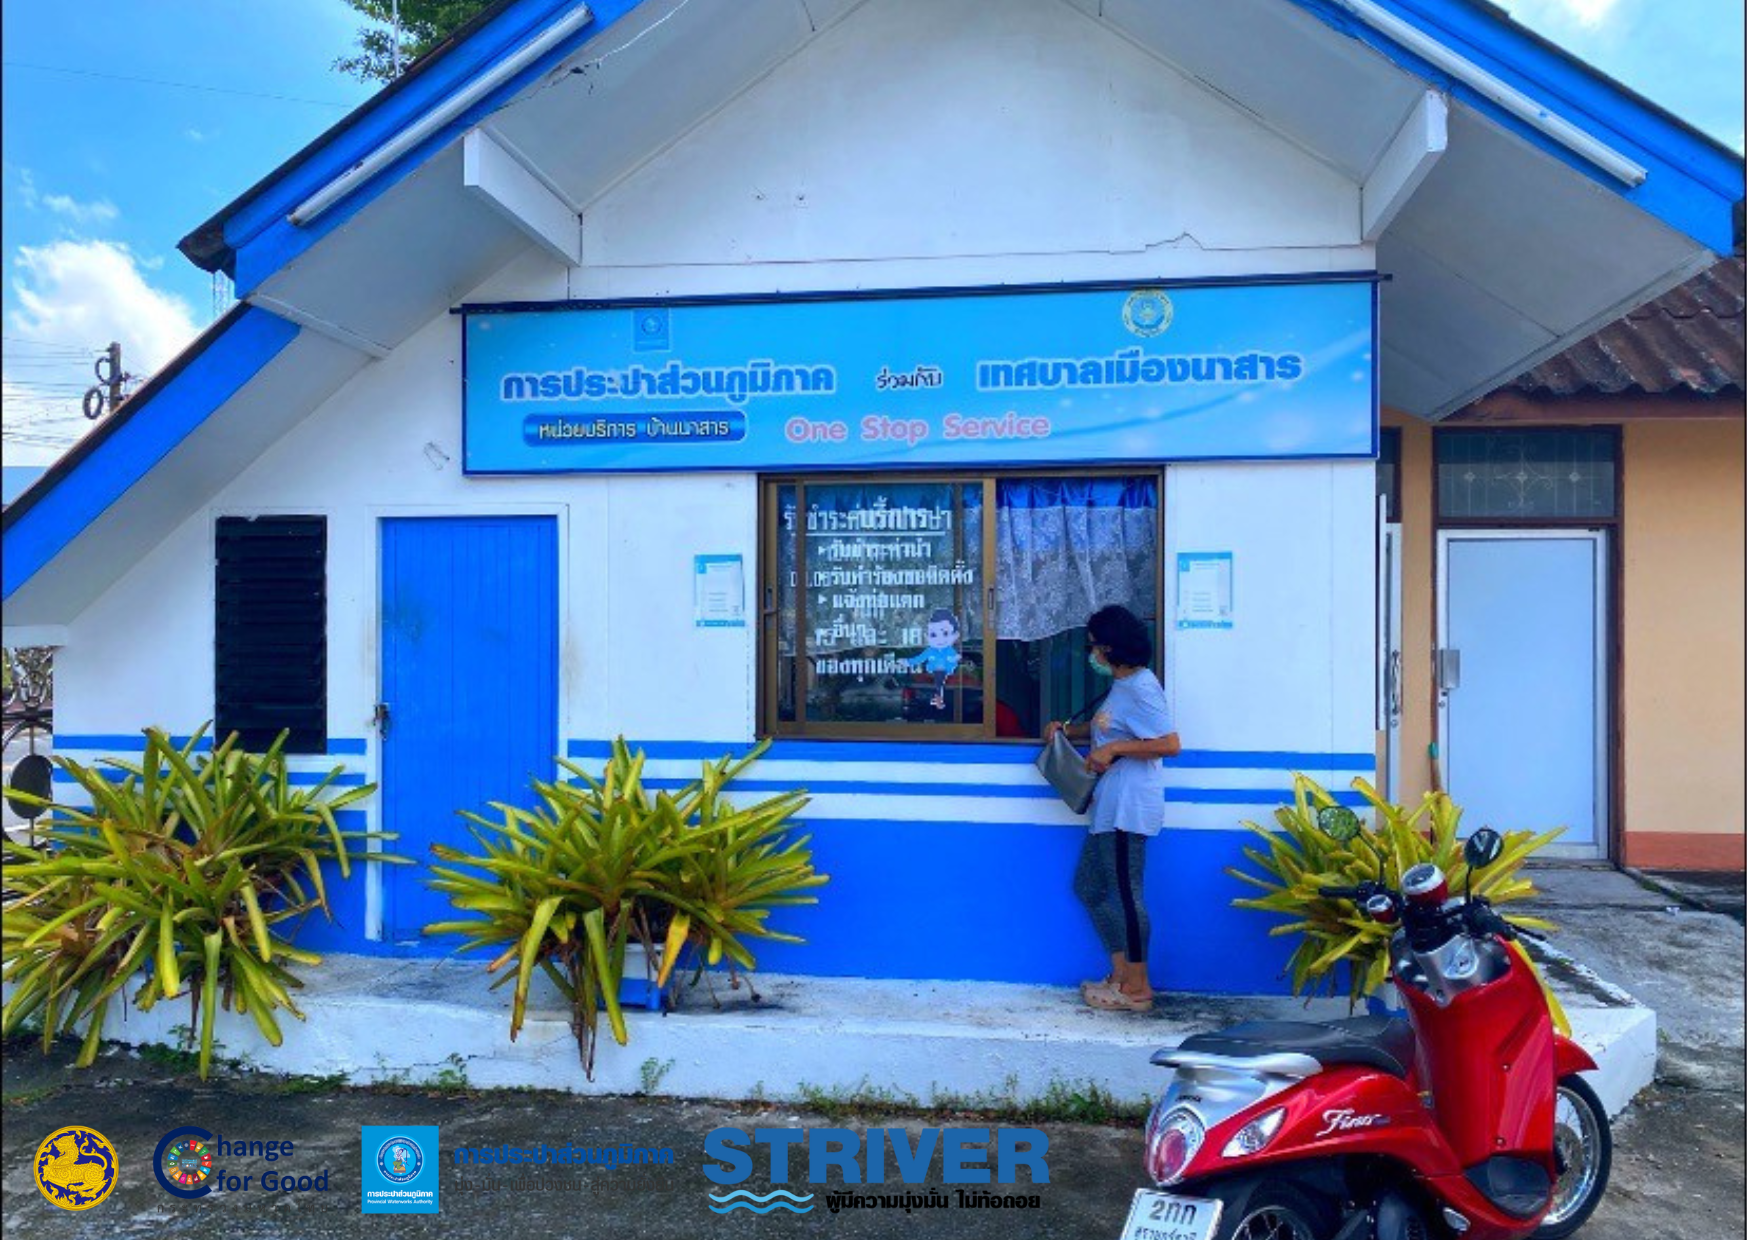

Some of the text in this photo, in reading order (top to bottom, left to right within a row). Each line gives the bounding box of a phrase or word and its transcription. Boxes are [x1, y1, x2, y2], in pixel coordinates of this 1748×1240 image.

[502, 350, 1303, 404] การประปาส่วนภูมิภาค ร่วมกับ เทศบาลเมืองนาสาร
[539, 416, 729, 439] หน่วยบริการ บ้านนาสาร
[786, 411, 1050, 445] One Stop Service
[1149, 1200, 1196, 1225] 2กก
